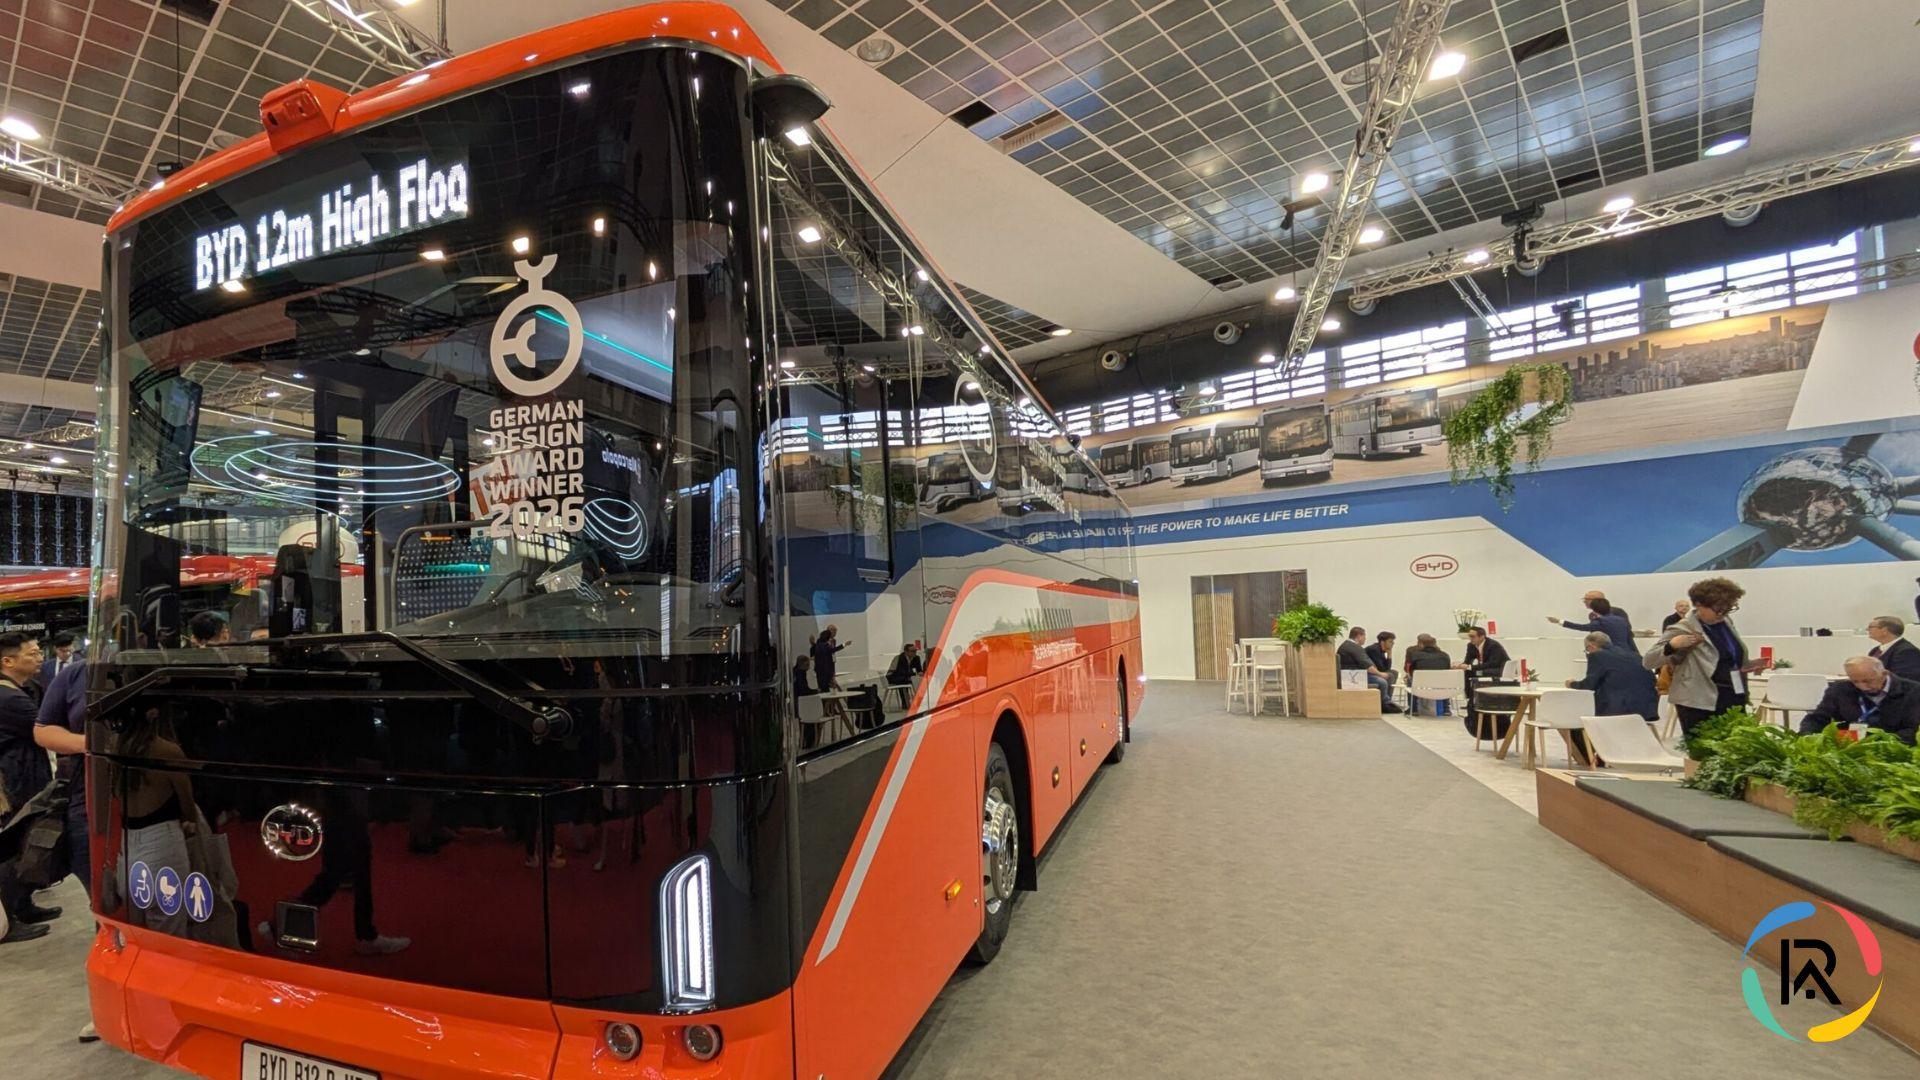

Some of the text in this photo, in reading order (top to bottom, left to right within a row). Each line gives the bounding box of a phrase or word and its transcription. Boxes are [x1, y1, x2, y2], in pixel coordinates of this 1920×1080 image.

[196, 223, 247, 290] BYD
[256, 209, 314, 272] 12m
[321, 174, 390, 252] High
[489, 399, 584, 429] GERMAN
[489, 421, 584, 452] DESIGN
[489, 447, 584, 478] AWARD
[489, 473, 584, 501] WINNER
[490, 496, 586, 539] 2026
[1137, 523, 1158, 535] THE
[1160, 519, 1203, 532] POWER
[1206, 516, 1222, 528] TO
[1224, 512, 1261, 526] MAKE
[1263, 509, 1291, 522] LIFE
[1294, 503, 1350, 519] BETTER
[1416, 561, 1454, 572] BYD
[266, 821, 314, 846] BYD
[259, 1052, 288, 1080] BYD
